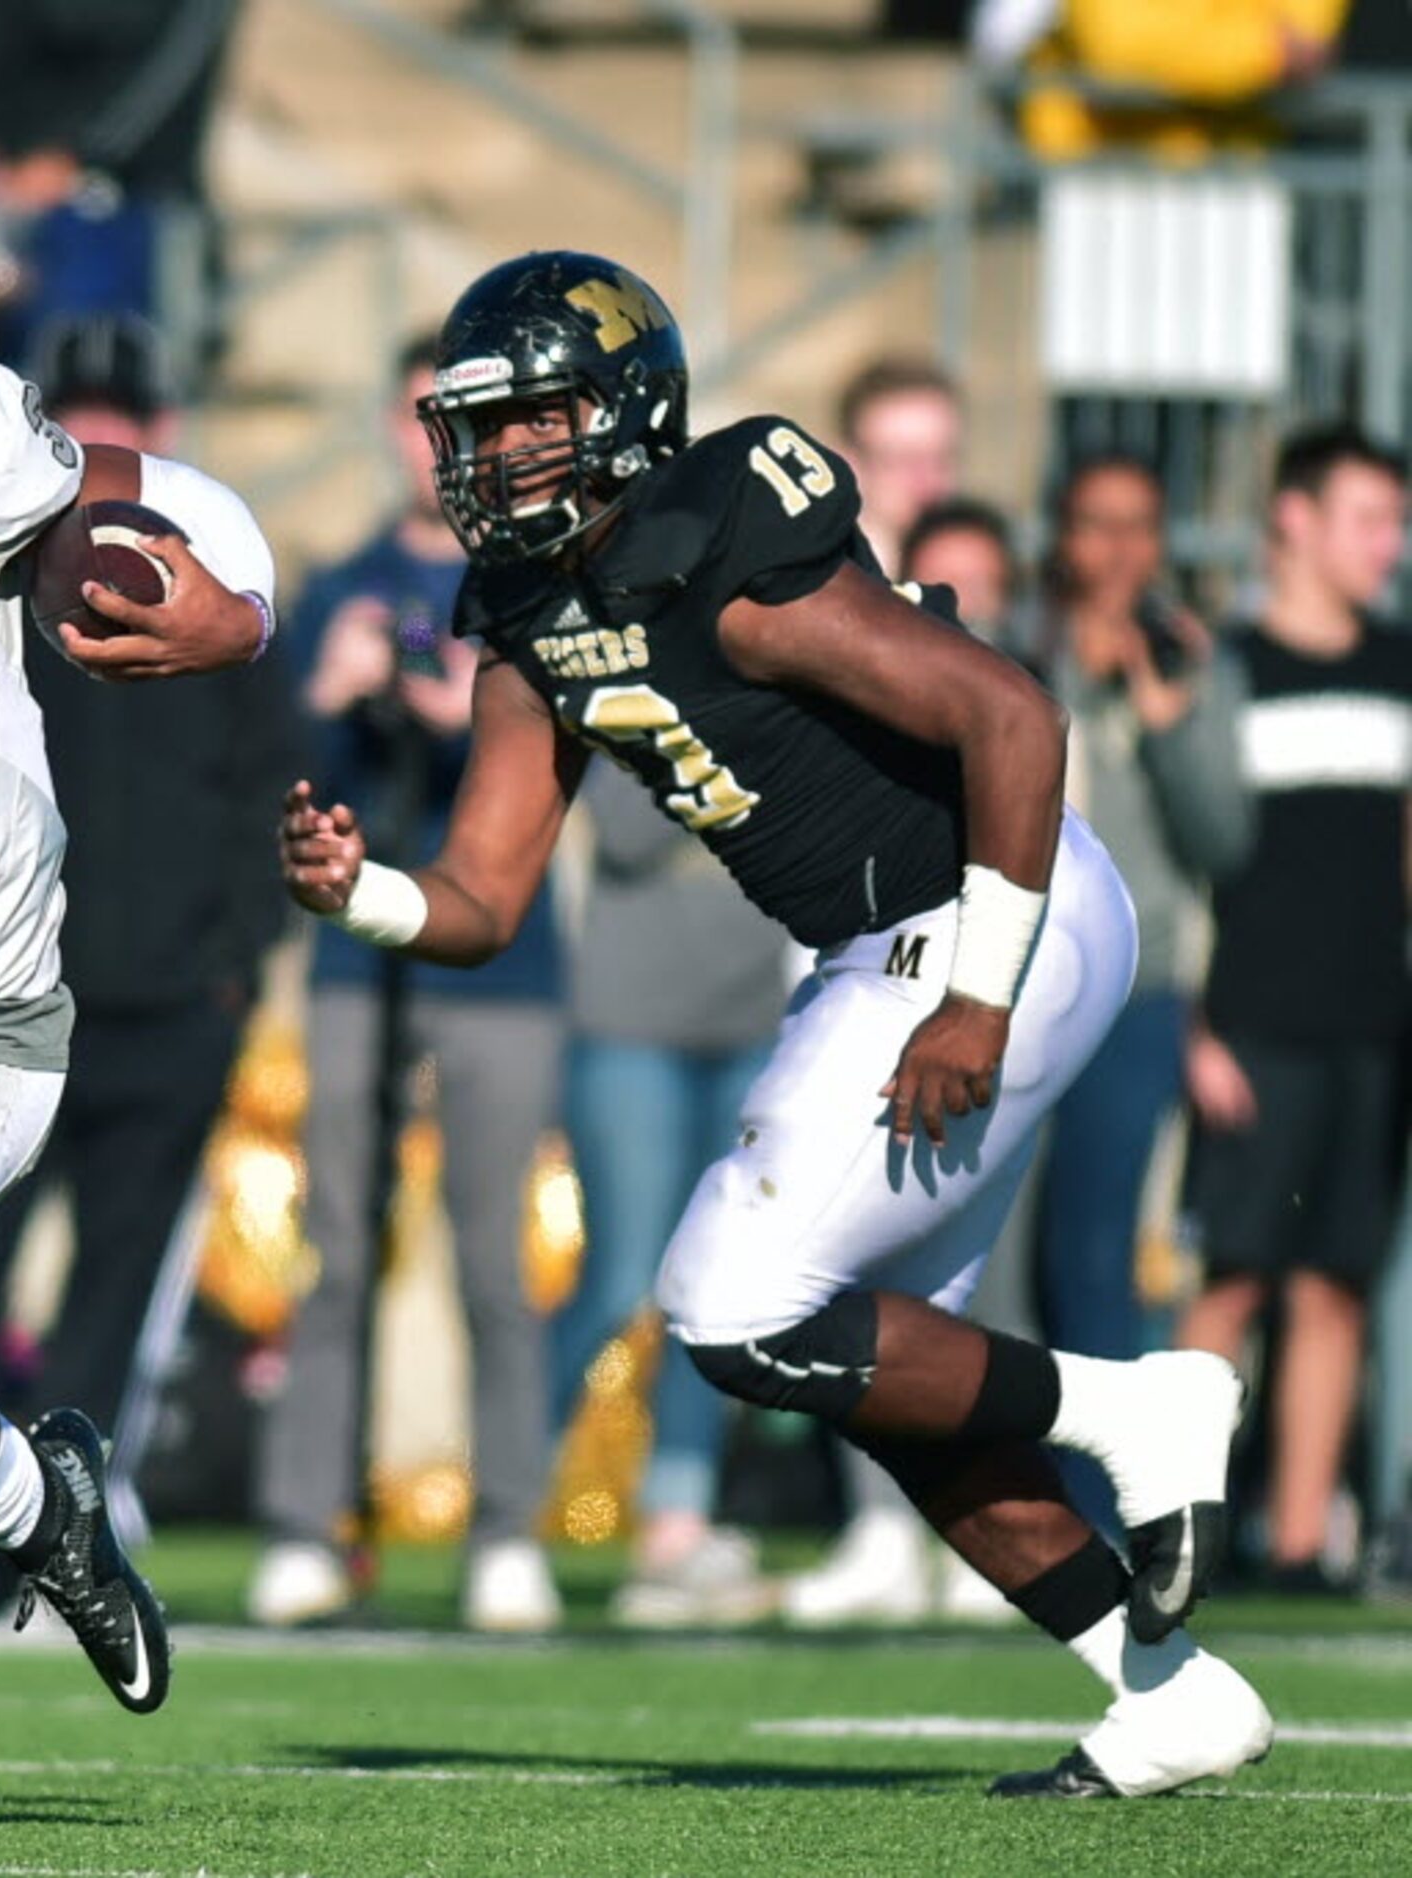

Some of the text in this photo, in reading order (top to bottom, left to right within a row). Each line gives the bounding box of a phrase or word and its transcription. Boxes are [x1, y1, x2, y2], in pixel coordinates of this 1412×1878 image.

[564, 267, 670, 353] M
[749, 427, 835, 517] 13
[884, 934, 929, 979] M
[49, 1448, 102, 1513] NIKE
